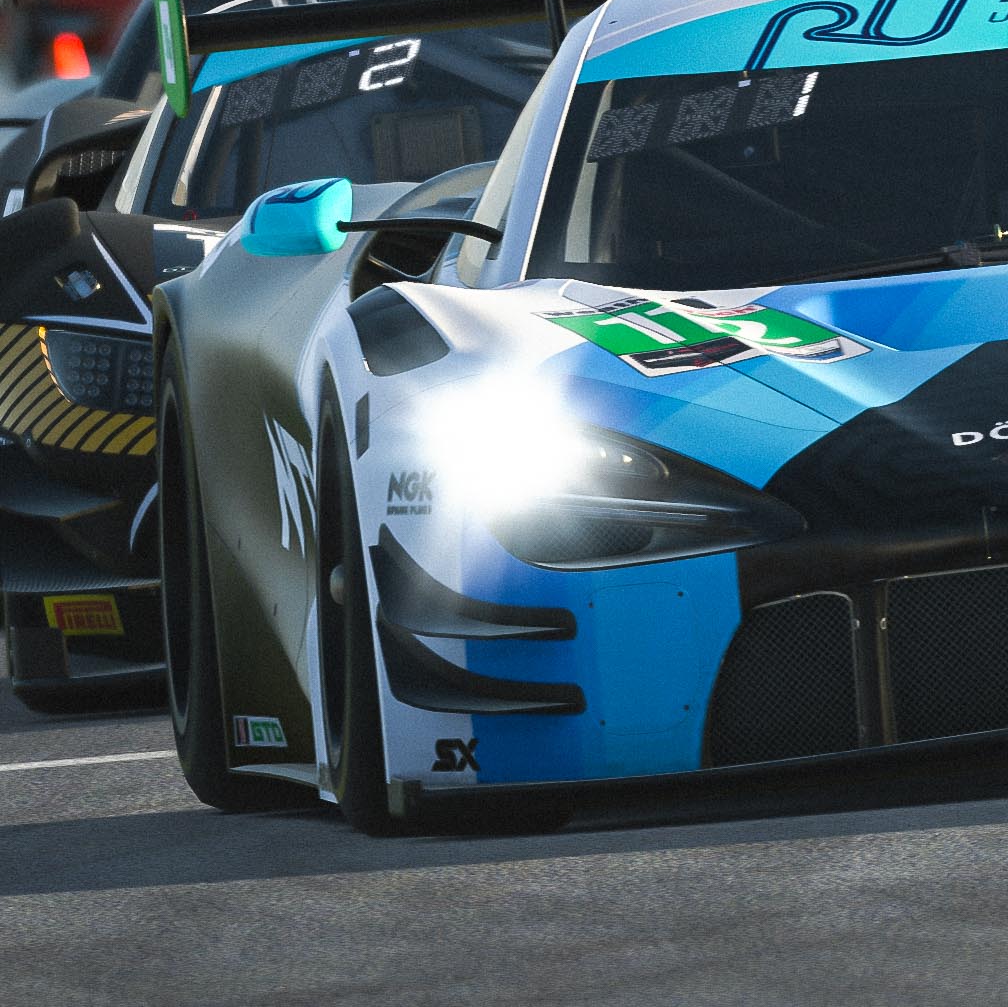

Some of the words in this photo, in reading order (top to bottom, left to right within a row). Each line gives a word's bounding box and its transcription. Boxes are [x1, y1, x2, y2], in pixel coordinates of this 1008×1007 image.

[357, 38, 422, 91] 2
[386, 470, 437, 503] NGK
[250, 719, 284, 742] GTD
[431, 737, 480, 772] SX
